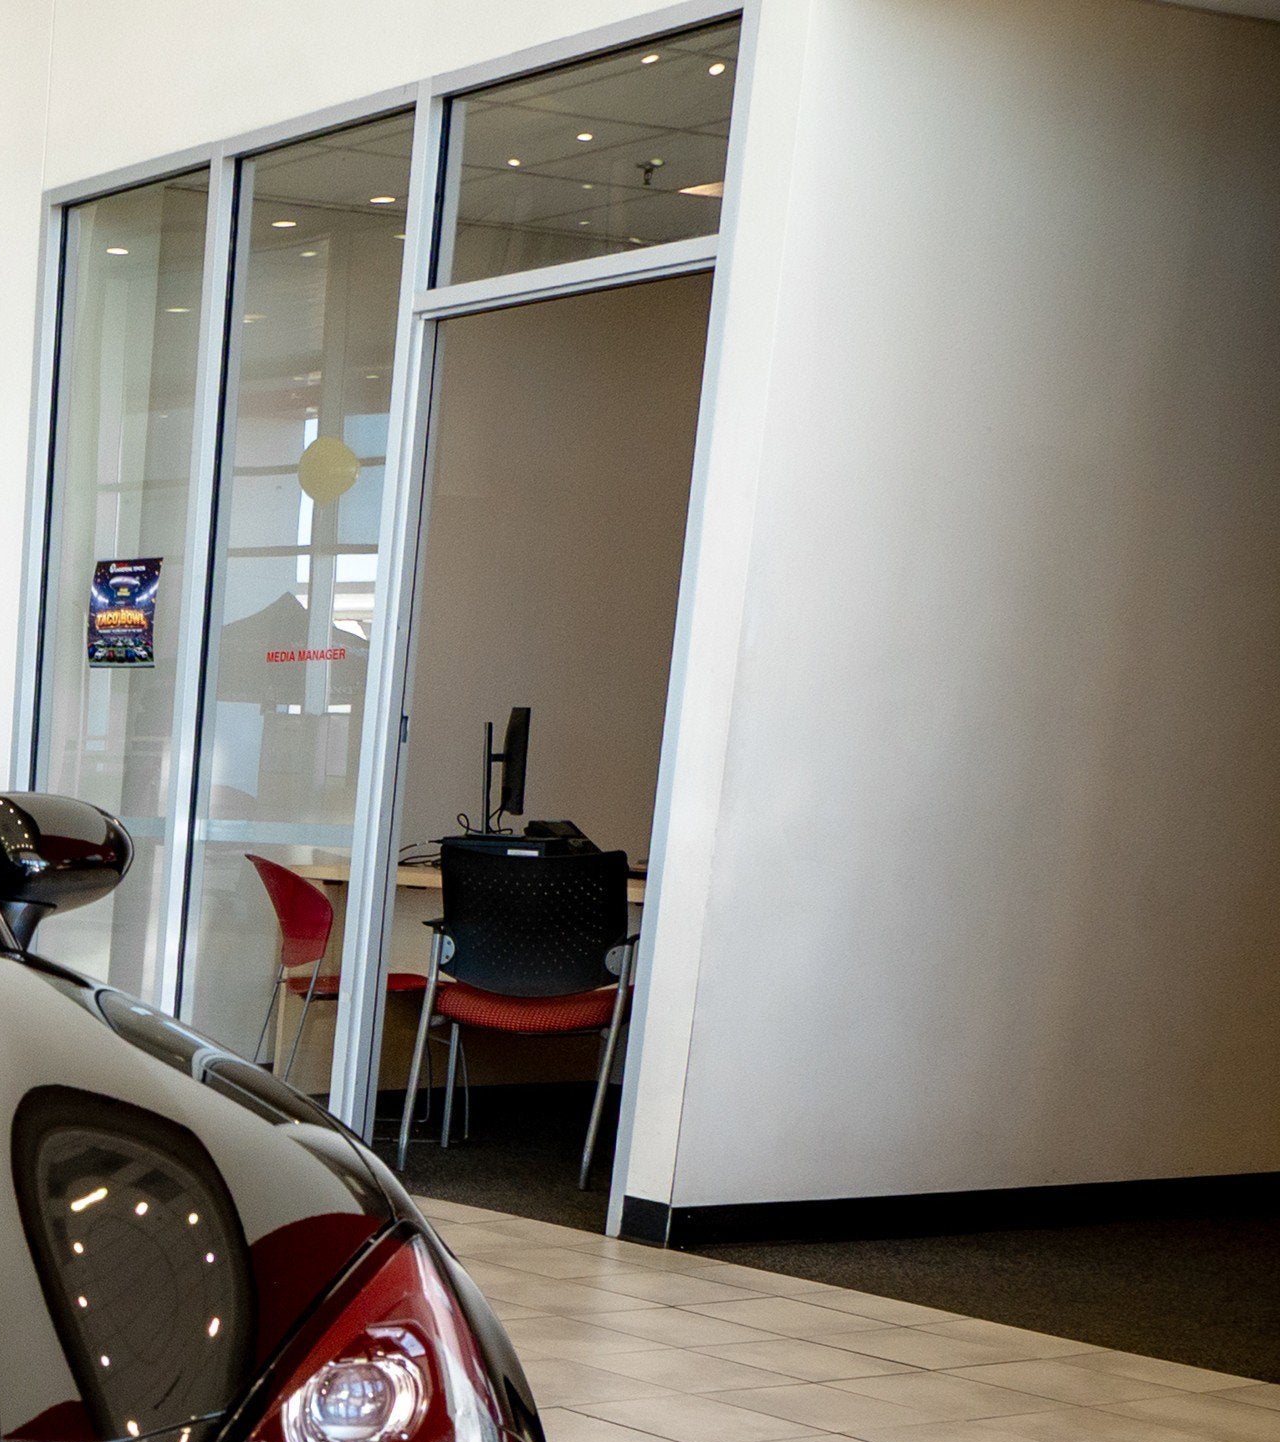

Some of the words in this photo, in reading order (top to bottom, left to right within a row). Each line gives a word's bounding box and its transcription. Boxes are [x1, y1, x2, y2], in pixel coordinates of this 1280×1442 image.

[97, 611, 119, 628] TACO
[120, 608, 147, 626] BOWL
[266, 651, 296, 662] MEDIA
[298, 648, 346, 662] MANAGER
